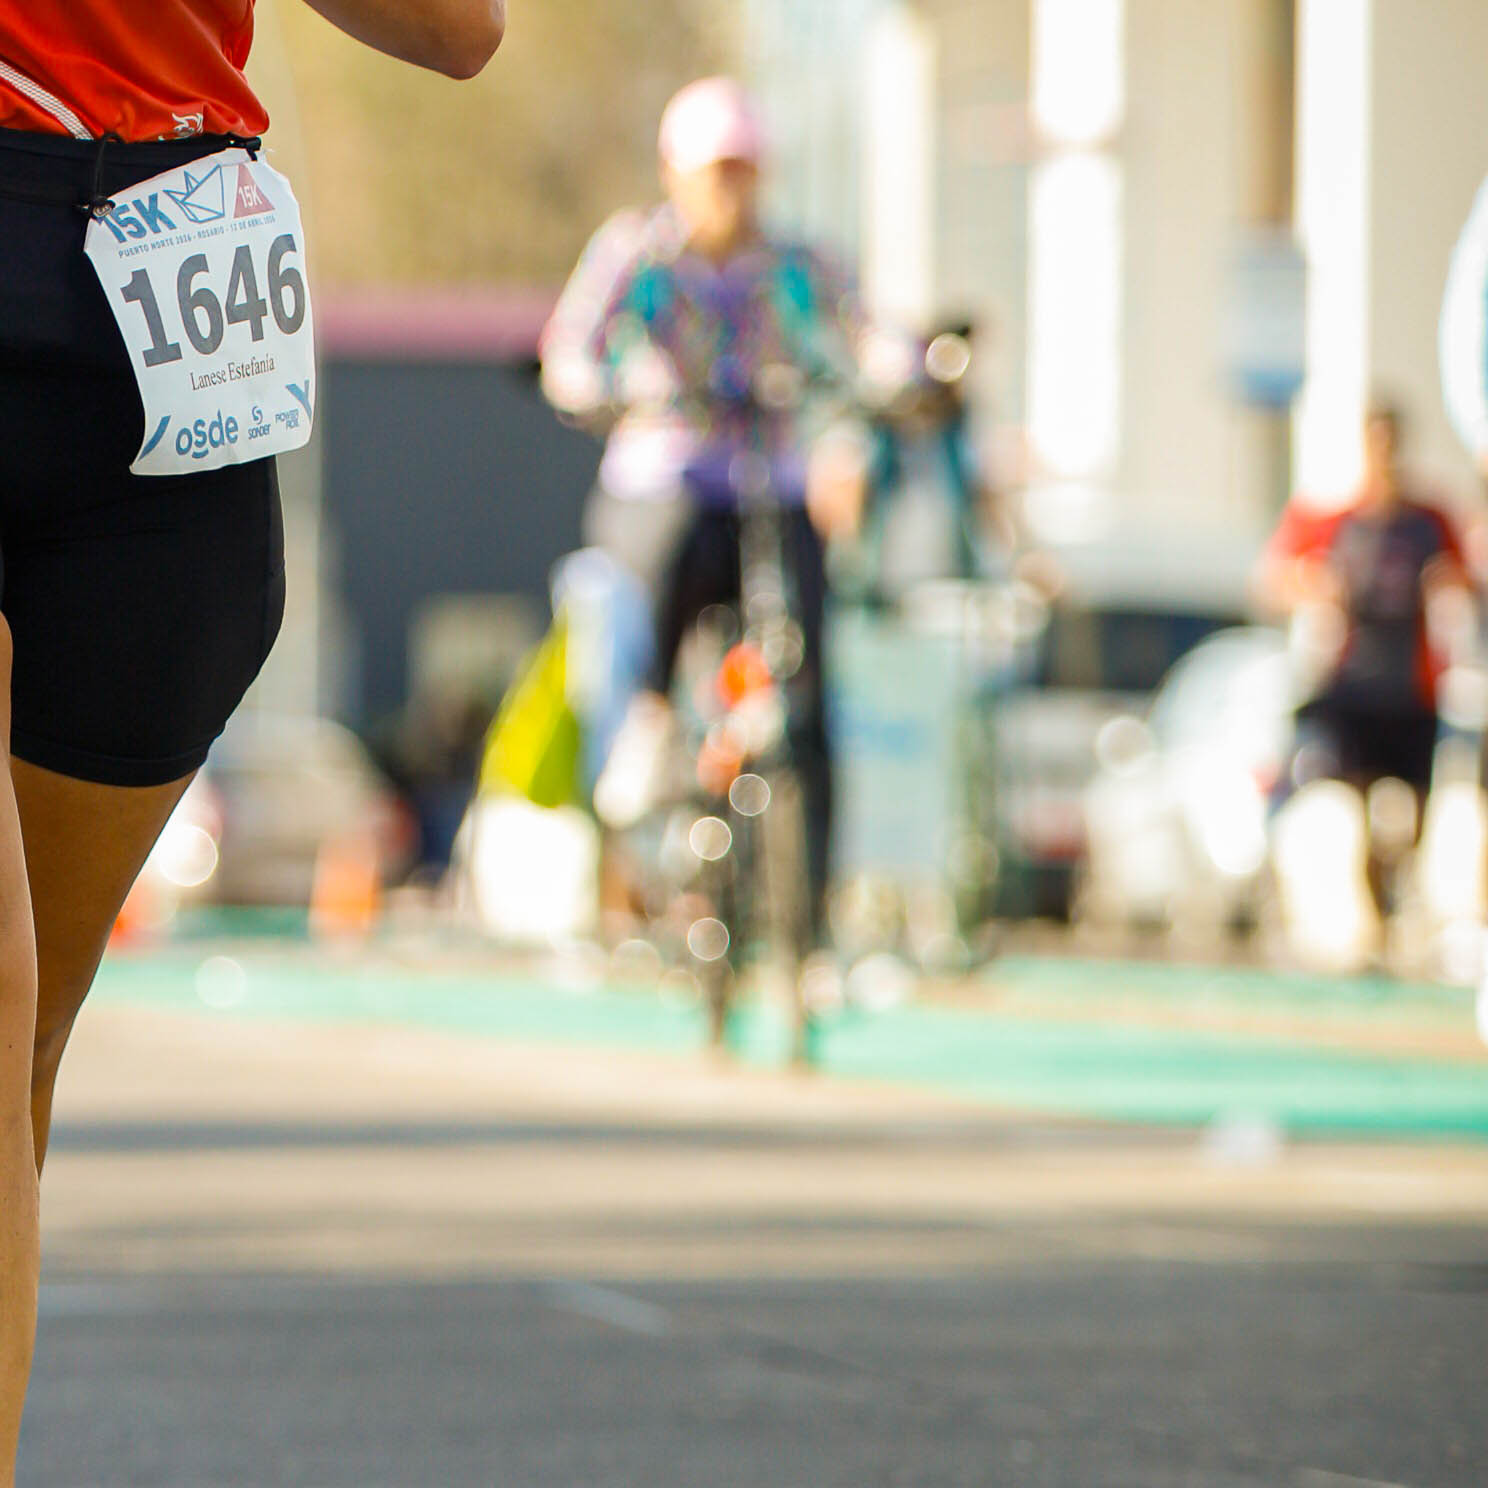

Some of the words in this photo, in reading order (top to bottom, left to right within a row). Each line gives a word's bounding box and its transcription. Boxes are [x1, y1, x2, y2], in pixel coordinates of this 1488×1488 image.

[96, 192, 177, 244] 15K
[238, 183, 263, 209] 15K
[120, 234, 305, 368] 1646
[190, 369, 227, 391] Lanese
[176, 408, 239, 456] osde
